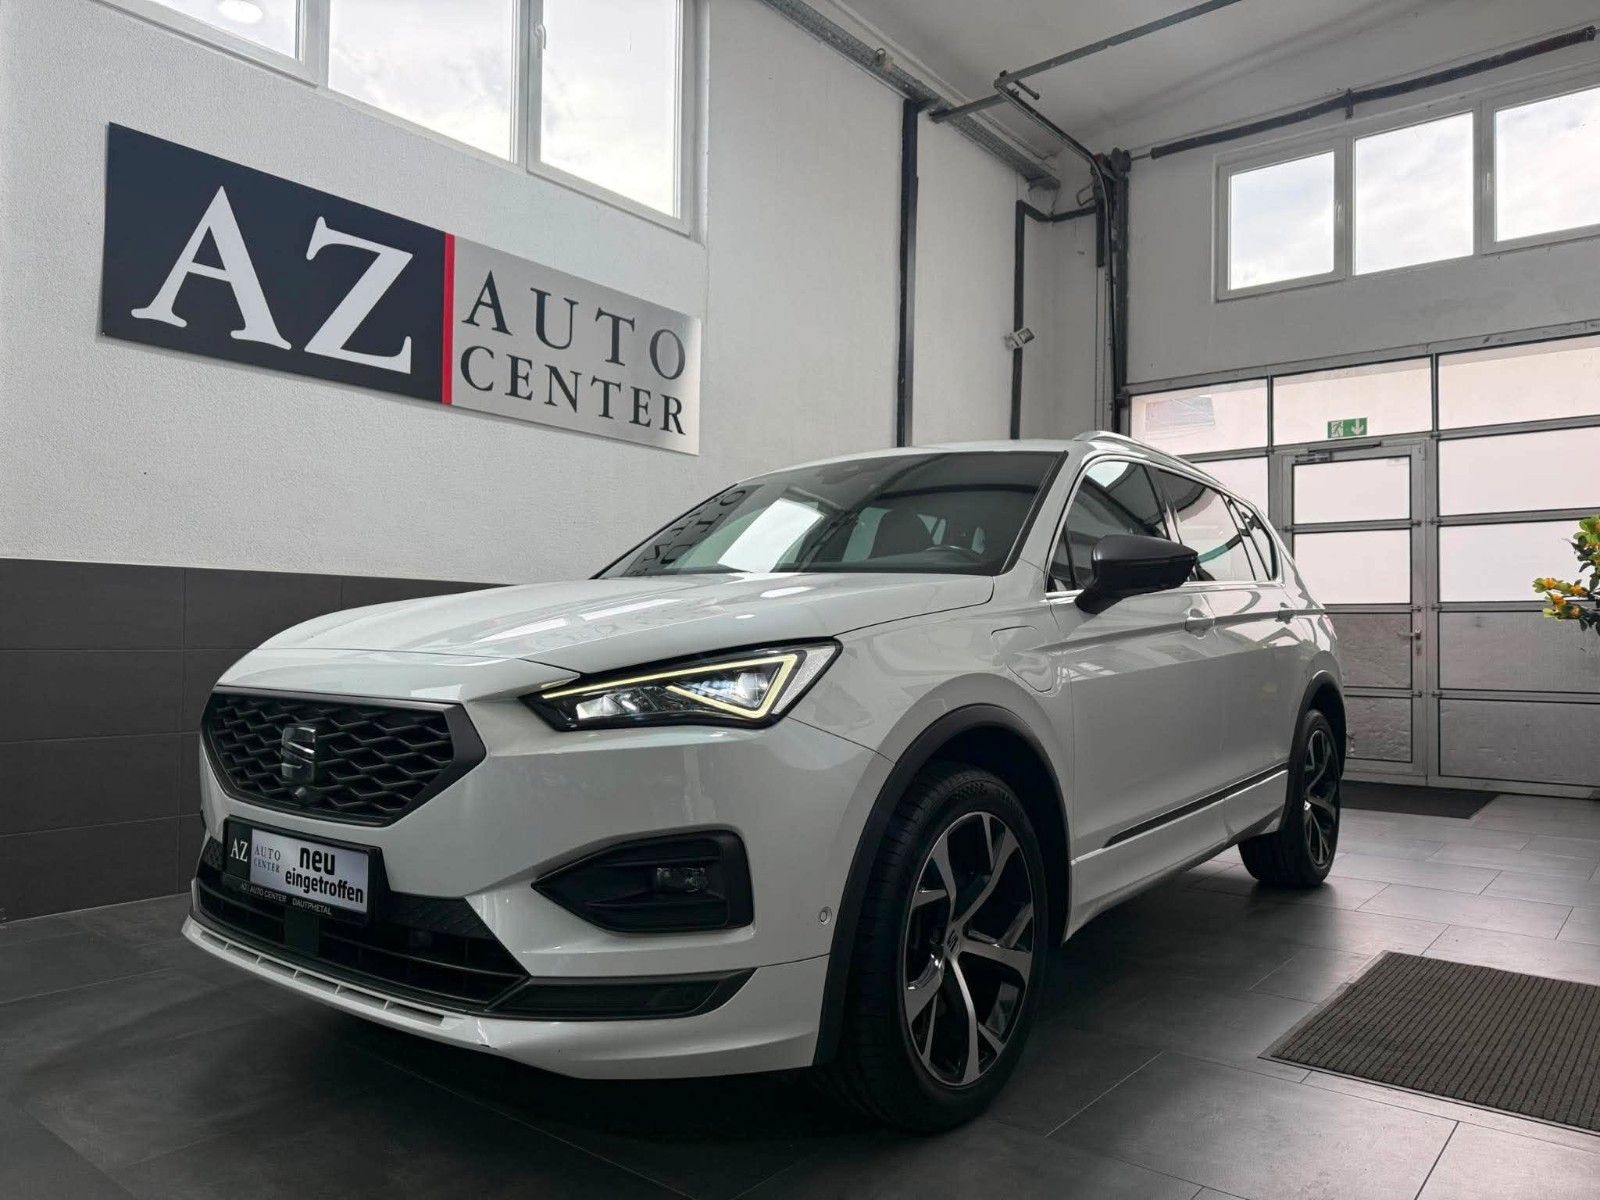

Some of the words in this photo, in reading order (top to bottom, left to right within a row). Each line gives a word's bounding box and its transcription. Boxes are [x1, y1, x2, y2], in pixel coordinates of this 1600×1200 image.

[131, 185, 413, 374] AZ
[461, 269, 687, 381] AUTO
[459, 345, 687, 435] CENTER
[230, 838, 248, 862] AZ
[255, 844, 281, 861] AUTO
[300, 847, 335, 875] neu
[253, 860, 280, 873] CENTER
[264, 890, 287, 902] CENTER
[285, 868, 363, 903] eingetroffen
